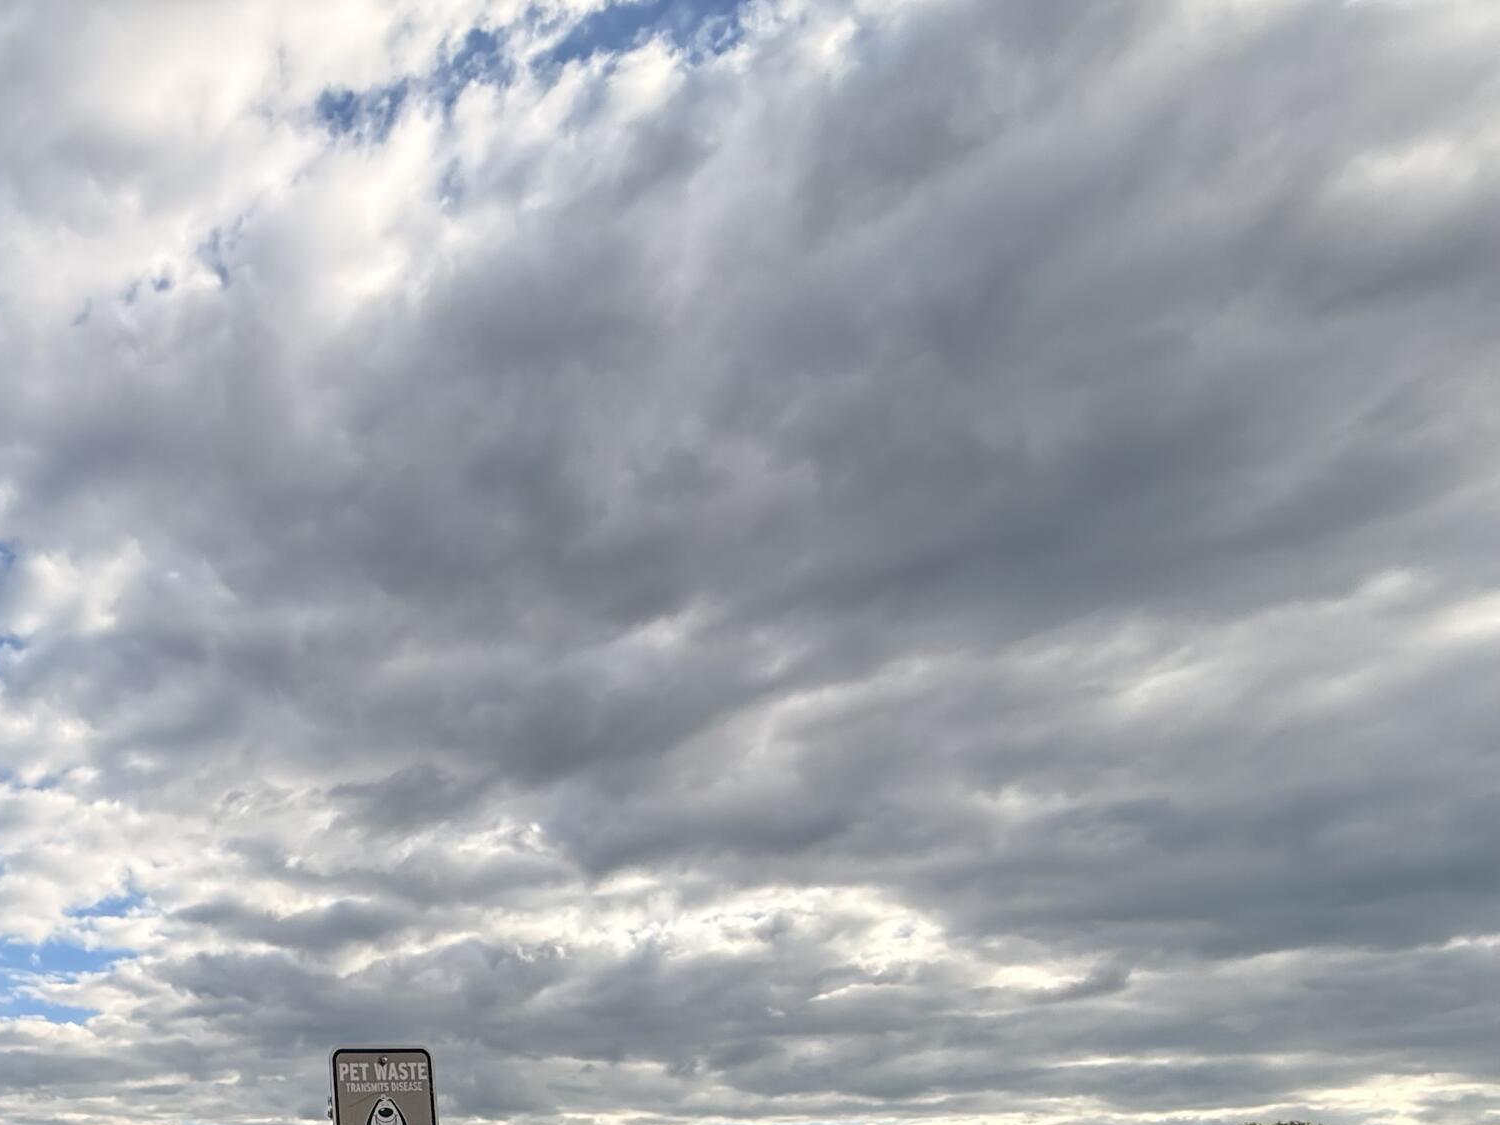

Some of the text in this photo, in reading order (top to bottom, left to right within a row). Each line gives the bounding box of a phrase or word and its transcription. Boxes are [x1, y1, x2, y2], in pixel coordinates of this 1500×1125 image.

[339, 1062, 427, 1081] PET WASTE
[346, 1081, 423, 1093] TRANSMITS DISEASE
